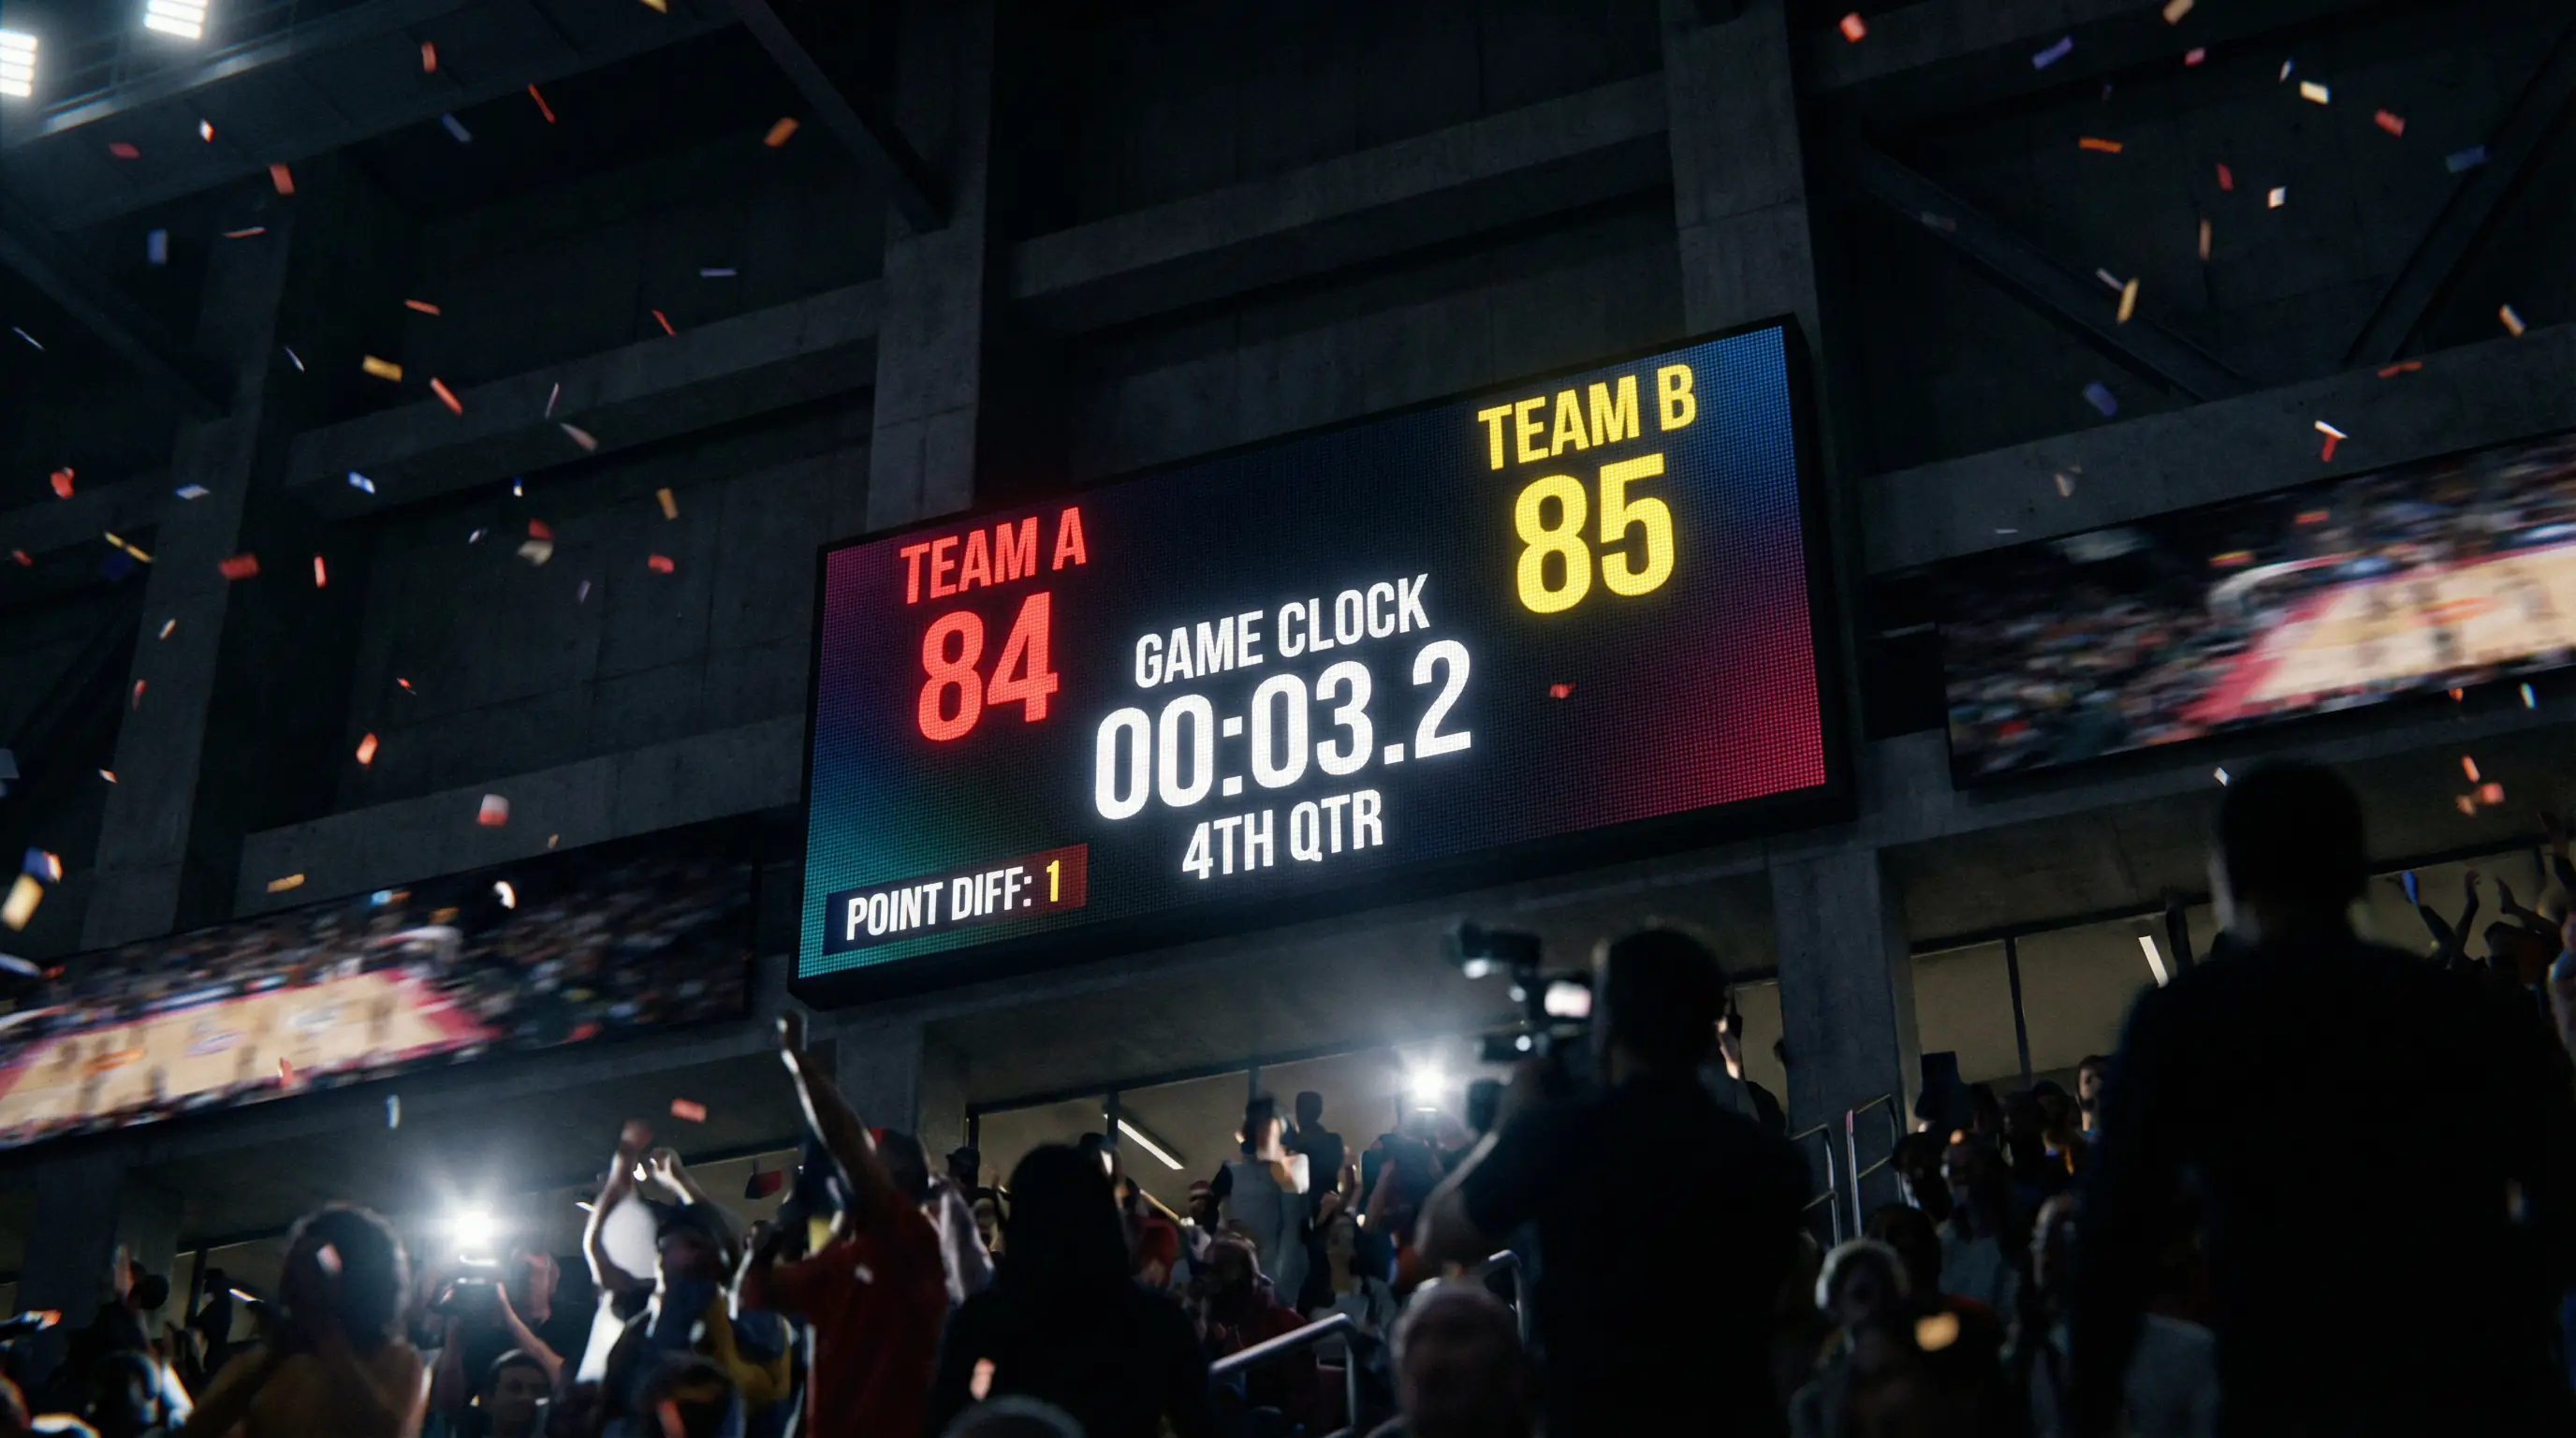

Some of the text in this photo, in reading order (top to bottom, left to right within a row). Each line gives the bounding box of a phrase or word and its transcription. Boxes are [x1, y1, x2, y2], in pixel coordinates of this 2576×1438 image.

[1478, 363, 1697, 470] TEAM B
[900, 506, 1088, 605] TEAM A
[1514, 452, 1676, 614] 85
[917, 591, 1059, 742] 84
[1134, 572, 1431, 689] GAME CLOCK
[1093, 638, 1472, 821] 00:03.2
[1181, 788, 1384, 881] 4TH QTR
[845, 859, 1061, 941] POINT DIFF: 1
